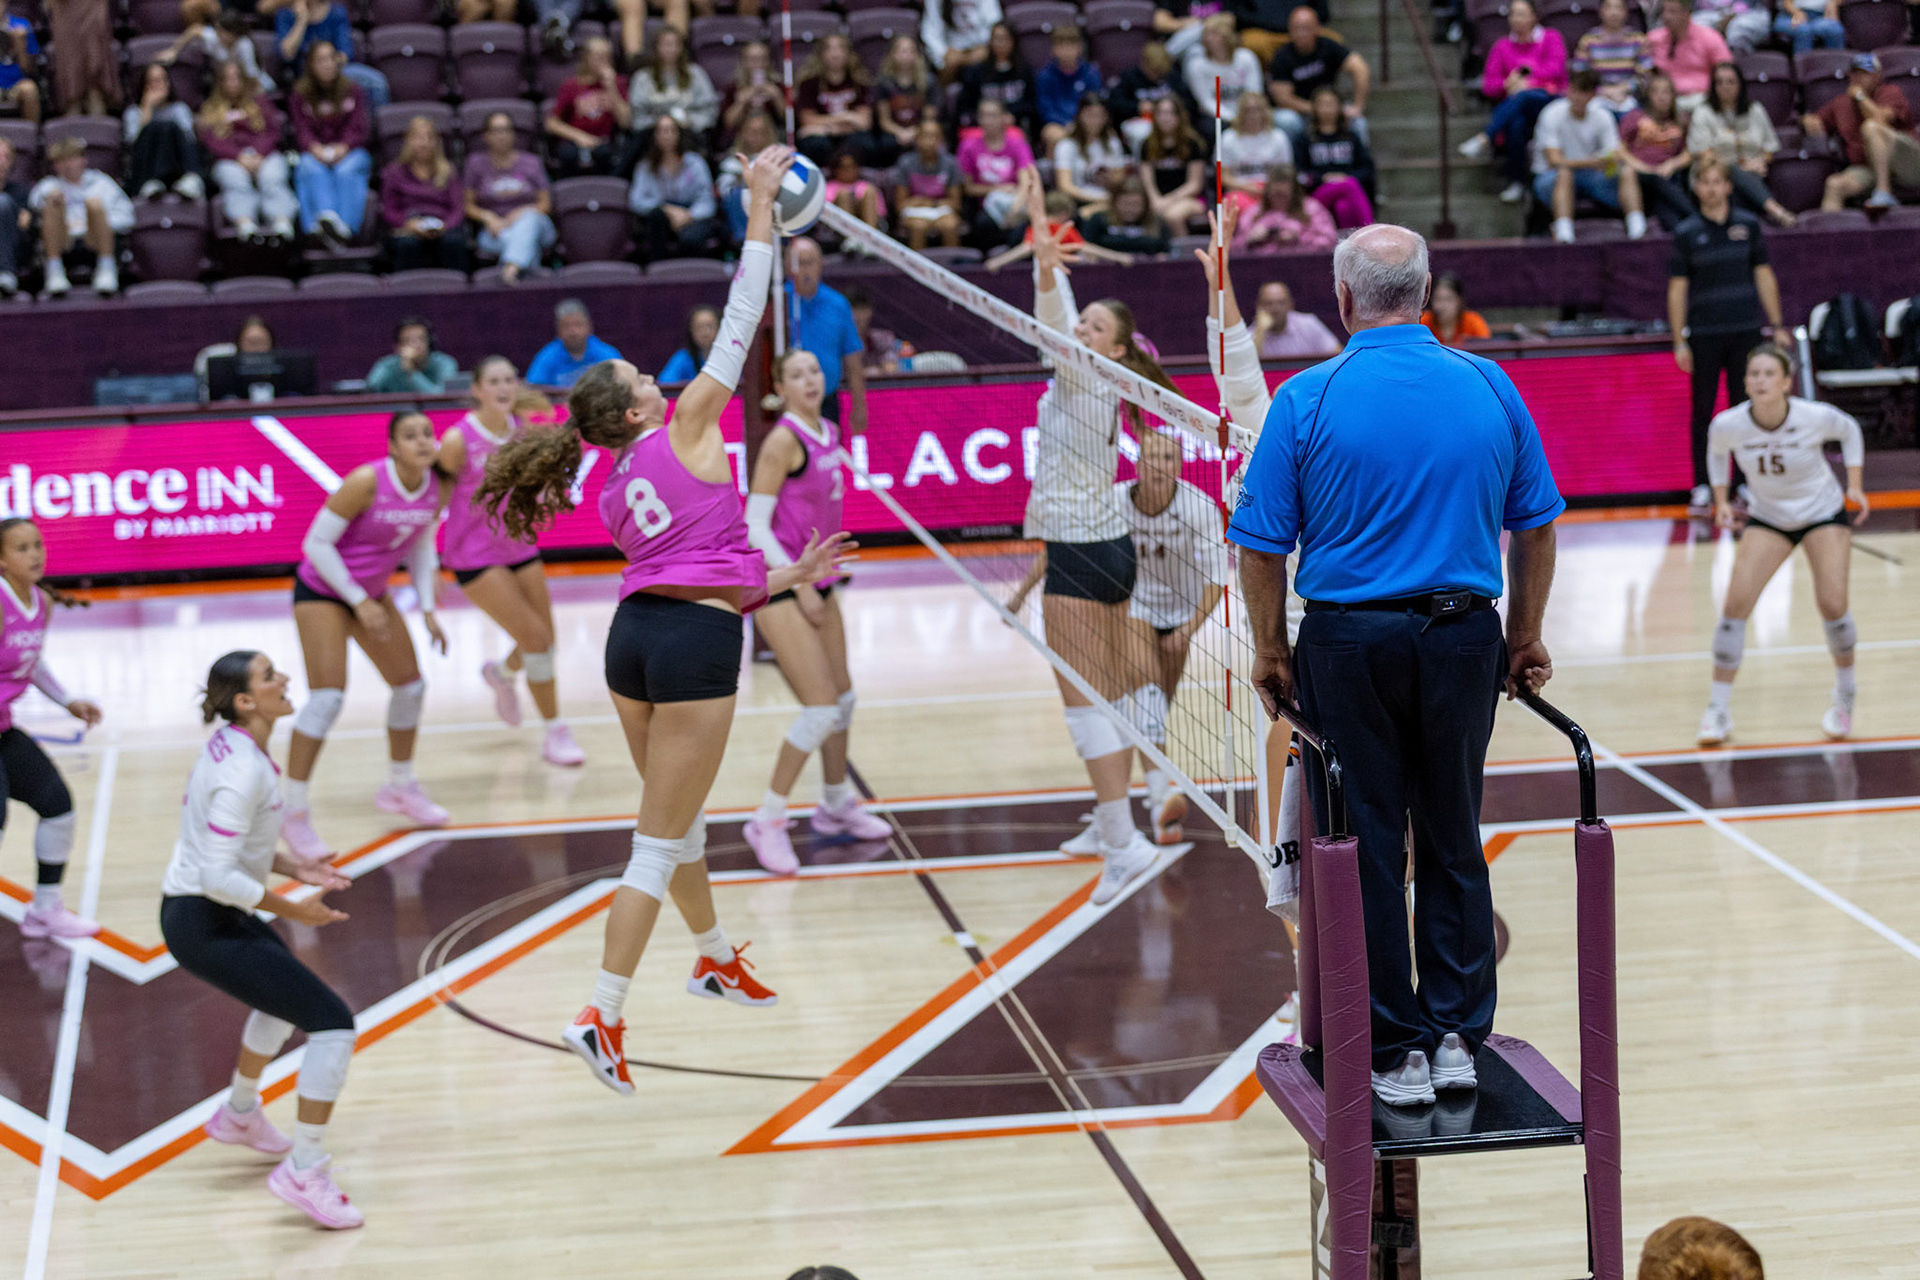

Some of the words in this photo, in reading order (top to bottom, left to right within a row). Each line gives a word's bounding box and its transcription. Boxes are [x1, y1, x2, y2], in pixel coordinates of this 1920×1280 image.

[1757, 453, 1786, 476] 15
[196, 463, 275, 510] INN
[625, 477, 672, 539] 8
[114, 519, 149, 540] BY
[151, 511, 275, 538] MARRIOTT
[389, 524, 414, 551] 7
